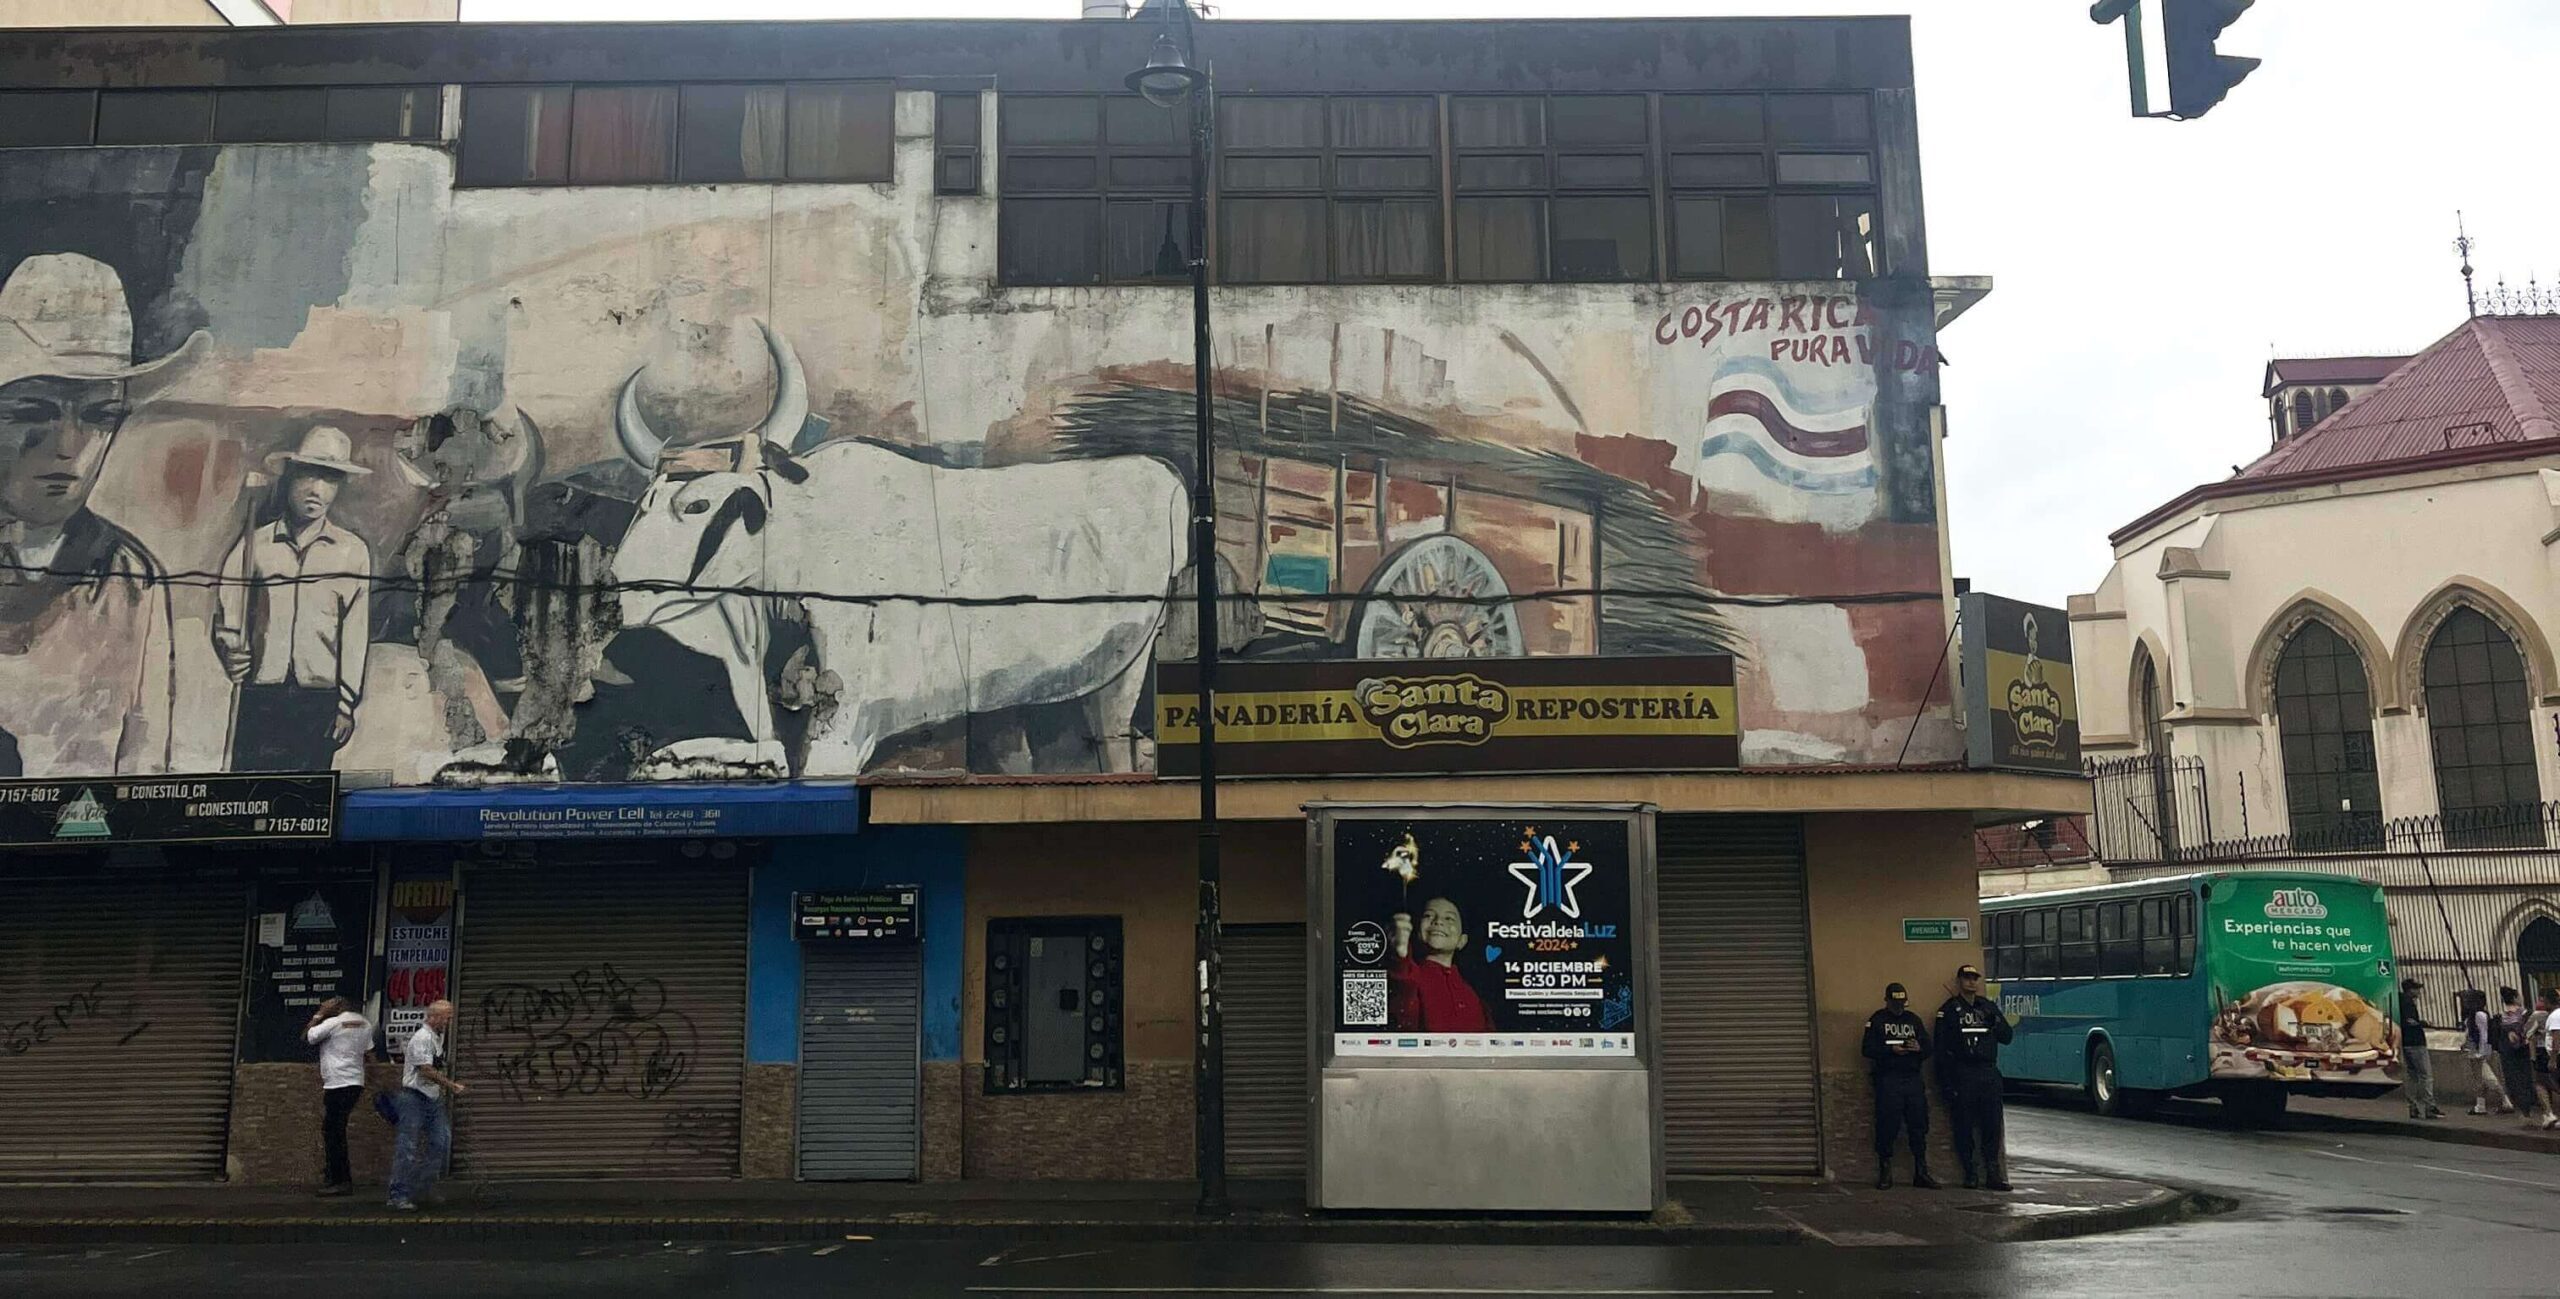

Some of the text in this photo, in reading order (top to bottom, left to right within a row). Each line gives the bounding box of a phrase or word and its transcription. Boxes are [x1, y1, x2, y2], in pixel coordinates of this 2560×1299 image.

[1655, 299, 1774, 348] COSTA
[1770, 335, 1852, 367] PURA
[1369, 680, 1505, 716] Santa
[1515, 691, 1720, 721] REPOSTERÍA
[2009, 683, 2061, 719] Santa
[1165, 696, 1358, 728] PANADERÍA
[1389, 709, 1485, 738] Clara
[2018, 709, 2055, 737] Clara
[0, 787, 60, 803] 7157-6012
[131, 784, 207, 800] CONESTILO_CR
[198, 800, 269, 817] CONESTILOCR
[479, 808, 562, 821] Revolution
[565, 807, 615, 821] Power
[618, 807, 645, 820] Cell
[268, 818, 329, 832] 7157-6012
[2273, 888, 2317, 908] auto
[392, 927, 448, 940] ESTUCHE
[1910, 926, 1940, 935] AVENIDA
[2224, 919, 2351, 939] Experiencias que
[1535, 939, 1570, 951] 2024
[2272, 938, 2374, 953] te hacen volver
[389, 950, 448, 962] TEMPERADO
[1504, 961, 1604, 973] 14 DICIEMBRE
[1521, 974, 1587, 987] 6:30 PM
[2004, 994, 2041, 1016] REGINA
